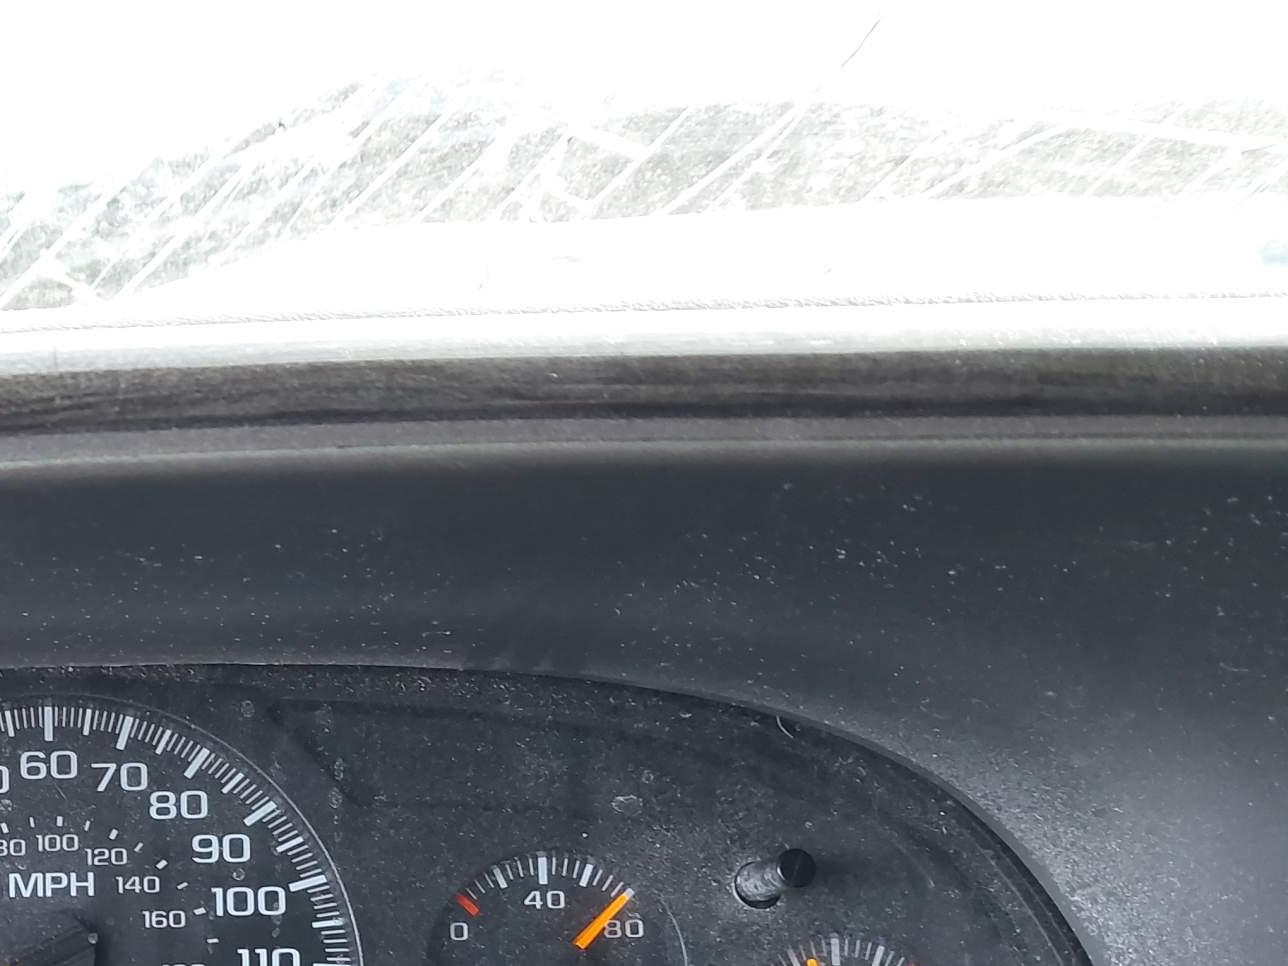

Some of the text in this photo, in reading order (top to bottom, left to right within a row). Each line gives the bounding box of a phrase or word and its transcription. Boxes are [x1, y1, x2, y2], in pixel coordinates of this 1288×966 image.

[20, 750, 78, 779] 60
[91, 763, 148, 791] 70
[149, 791, 208, 819] 80
[36, 835, 79, 852] 100
[192, 834, 250, 863] 90
[85, 848, 127, 865] 120
[8, 873, 94, 897] MPH
[116, 876, 160, 893] 140
[211, 887, 286, 916] 100
[524, 890, 566, 909] 40
[142, 910, 186, 928] 160
[604, 919, 644, 938] 80
[450, 922, 469, 941] 0
